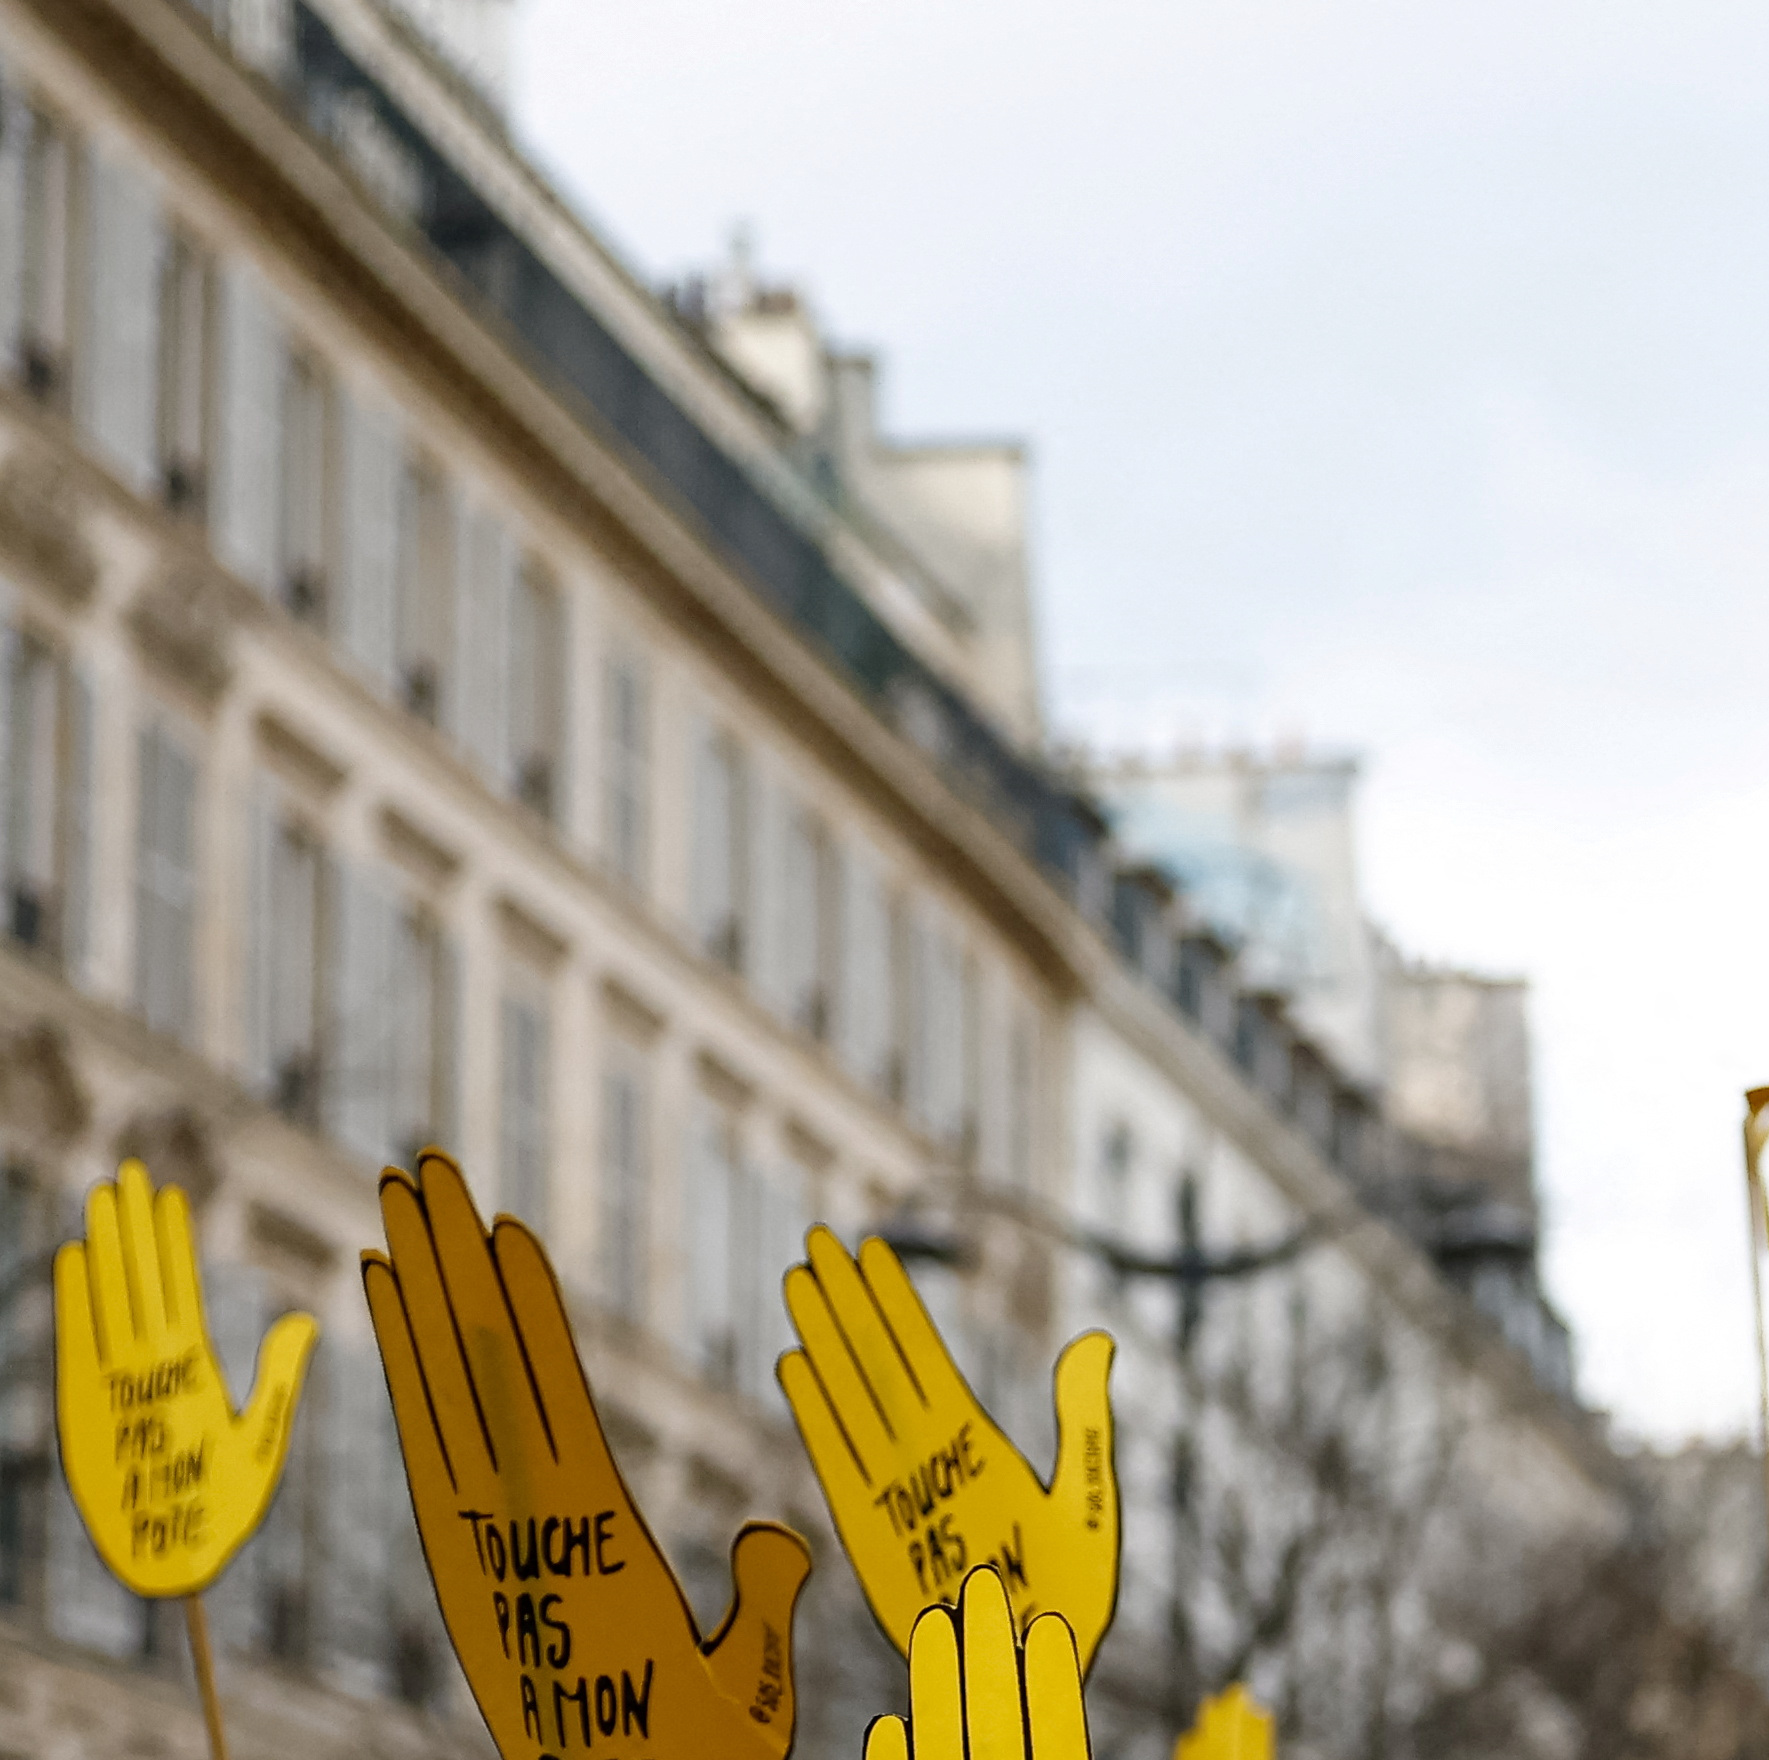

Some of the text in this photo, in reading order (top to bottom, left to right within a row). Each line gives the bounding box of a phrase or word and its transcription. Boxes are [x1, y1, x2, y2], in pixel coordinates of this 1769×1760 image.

[873, 1419, 987, 1538] TOUCHE
[458, 1510, 626, 1582] TOUCHE
[908, 1513, 967, 1595] PAS
[493, 1591, 570, 1669] PAS
[520, 1658, 654, 1748] A MON
